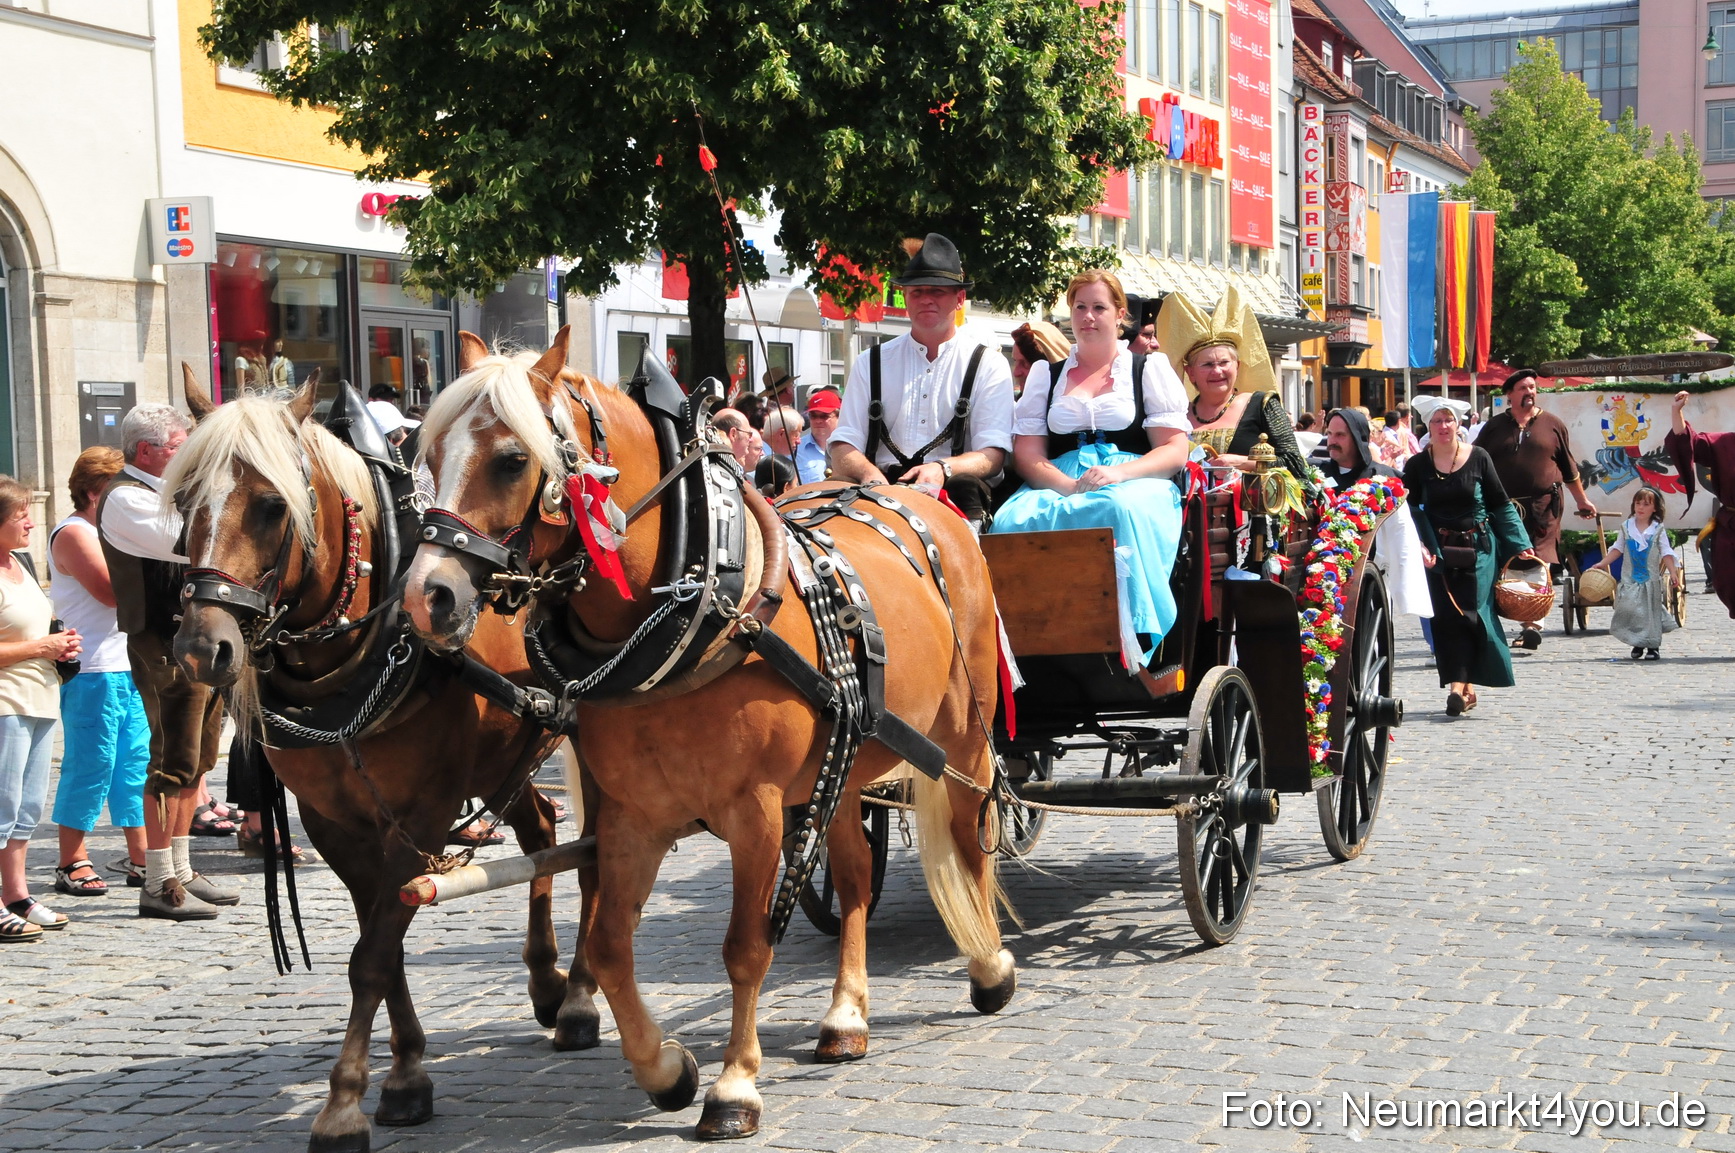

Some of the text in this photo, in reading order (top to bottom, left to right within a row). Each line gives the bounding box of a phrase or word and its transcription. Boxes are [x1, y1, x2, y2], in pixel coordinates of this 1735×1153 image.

[1257, 9, 1269, 24] SALE
[1251, 42, 1263, 57] SALE
[1258, 80, 1270, 95] SALE
[1251, 113, 1264, 128] SALE
[1259, 151, 1271, 165] SALE
[1252, 184, 1265, 197] SALE
[1303, 106, 1319, 267] BÄCKEREI
[168, 243, 192, 252] Maestro
[1303, 274, 1322, 287] café
[727, 380, 741, 408] SALE
